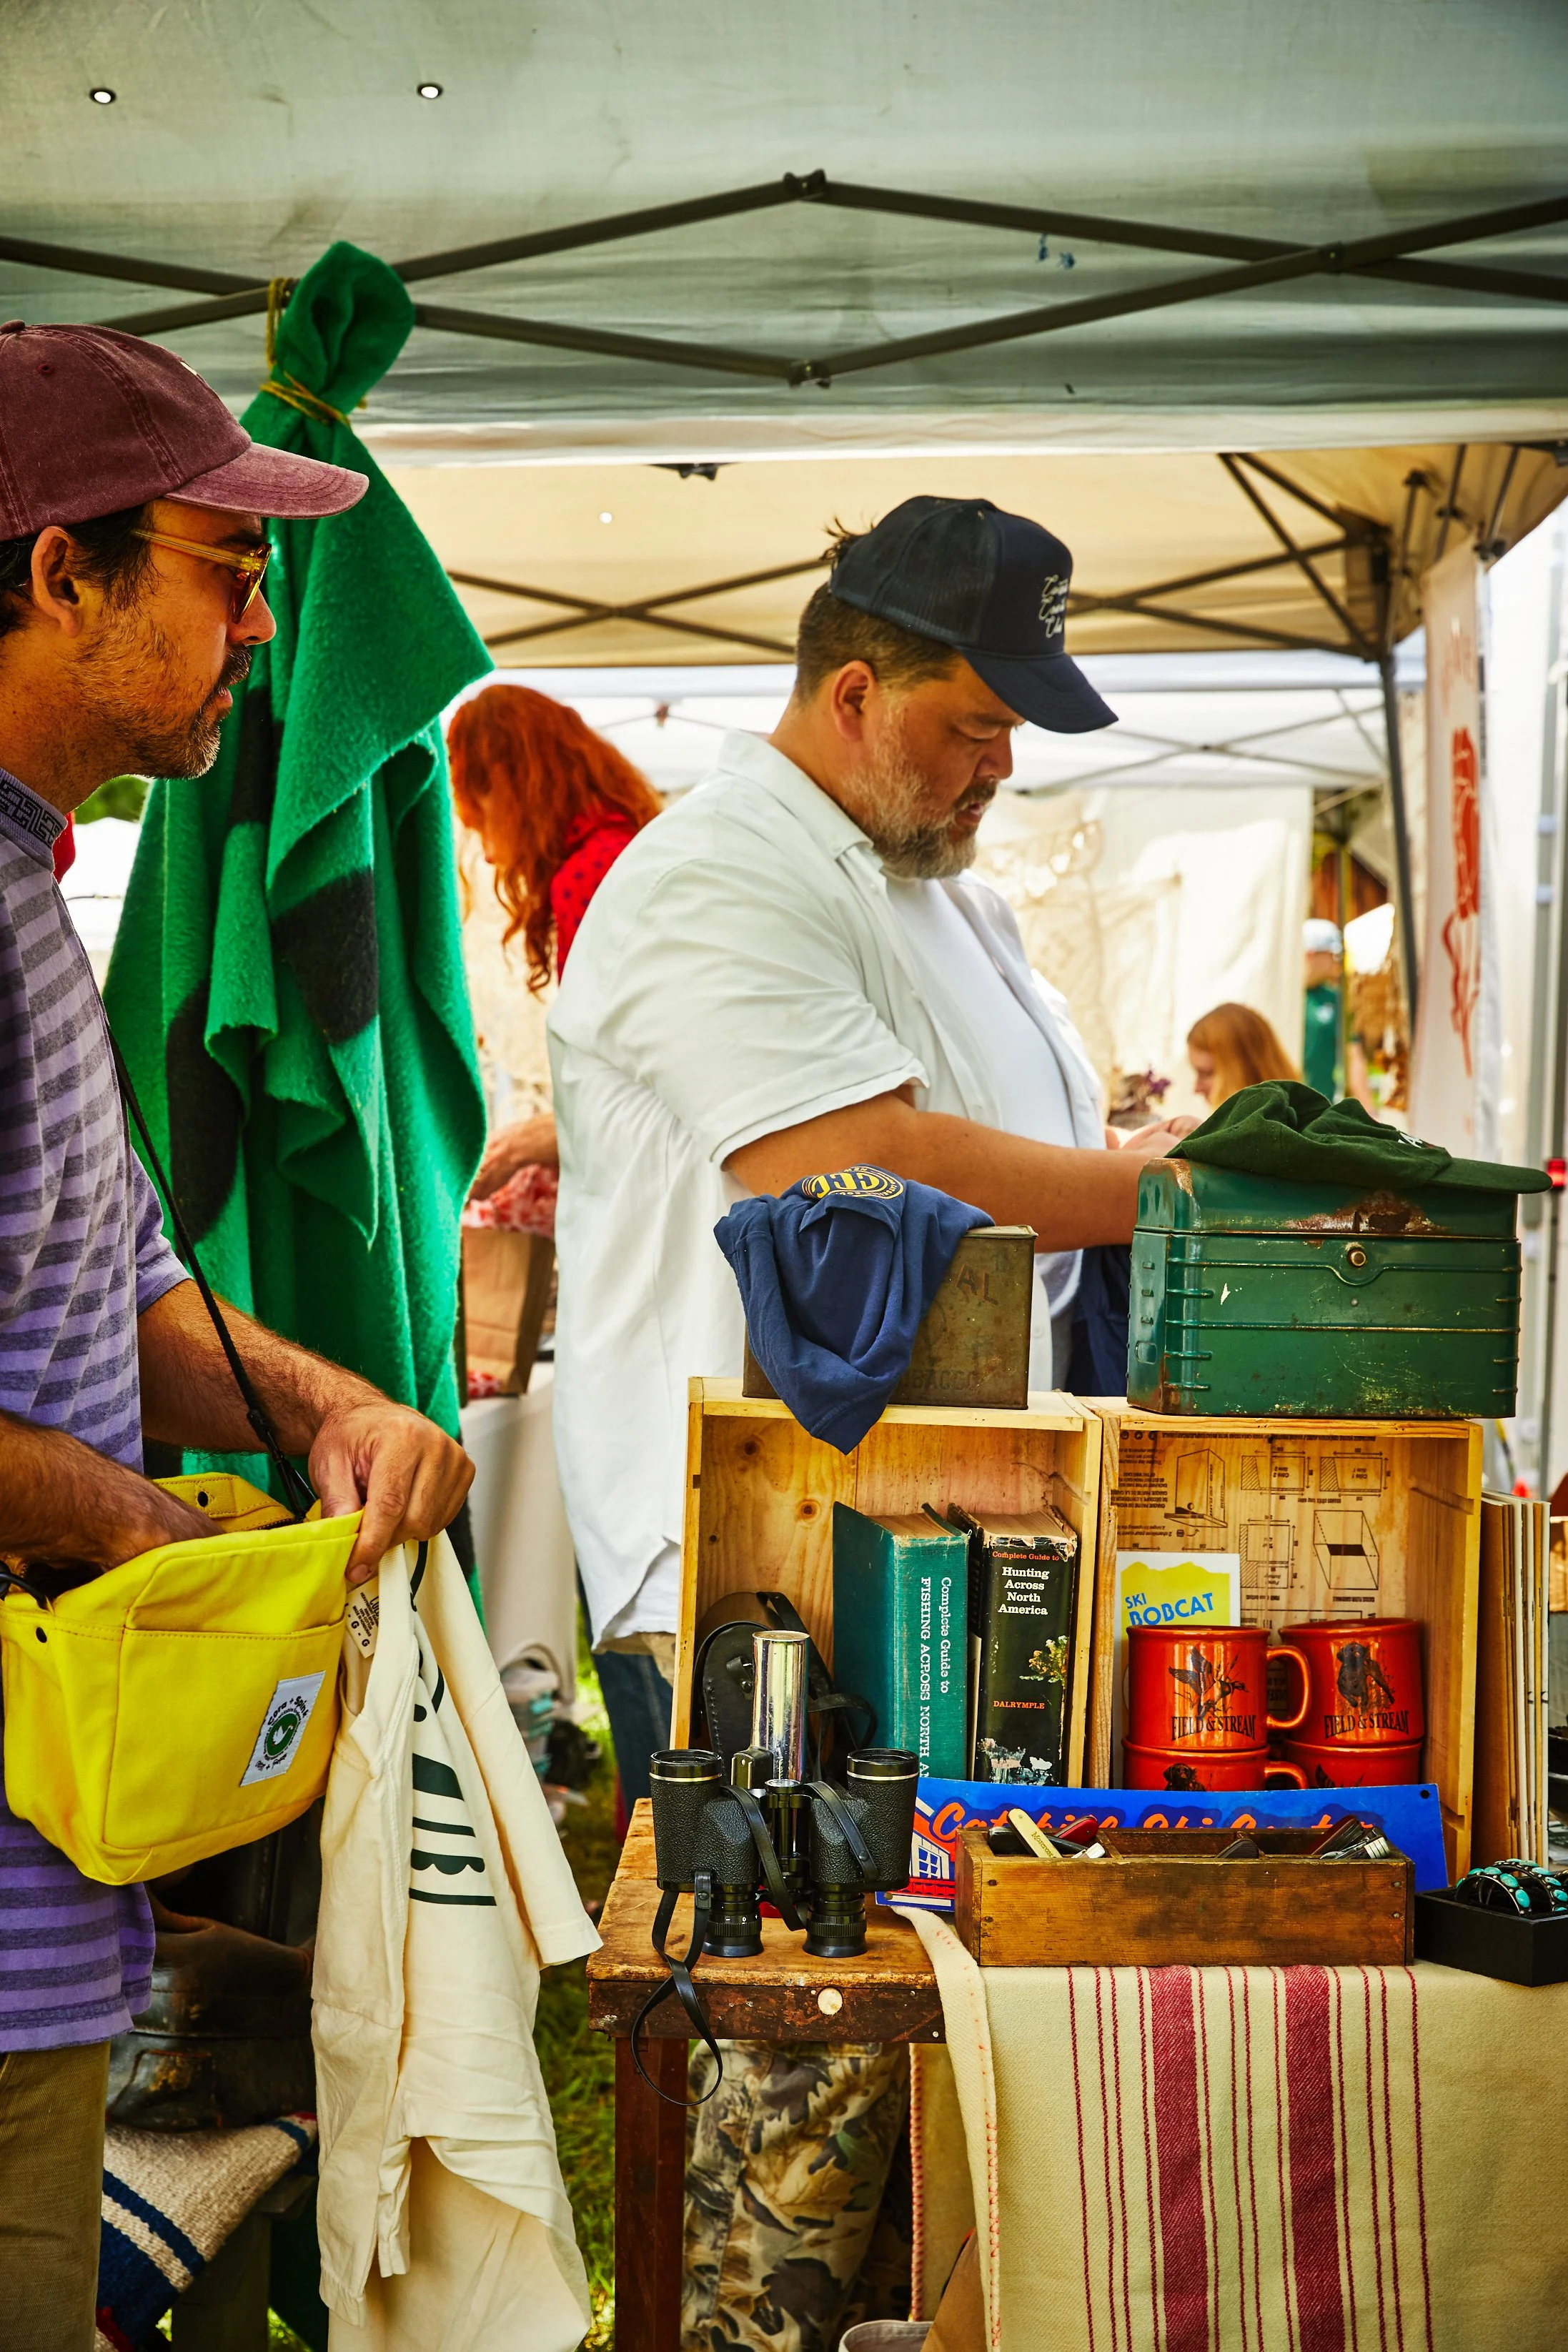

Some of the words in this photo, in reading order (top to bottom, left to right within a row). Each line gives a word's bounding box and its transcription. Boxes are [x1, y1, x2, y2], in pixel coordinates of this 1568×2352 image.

[992, 1551, 1027, 1560] Complete
[1001, 1566, 1051, 1580] Hunting
[1003, 1579, 1045, 1591] Across
[1006, 1591, 1041, 1602] North
[1124, 1592, 1148, 1609] SKI
[921, 1577, 931, 1641] FISHING
[939, 1577, 952, 1637] Complete
[997, 1603, 1048, 1615] America
[1128, 1592, 1215, 1626] BOBCAT
[359, 1619, 372, 1637] HONDURAS
[363, 1617, 372, 1630] COTTON
[940, 1639, 951, 1678] Guide
[920, 1643, 931, 1702] ACROSS
[940, 1679, 950, 1694] to
[267, 1701, 287, 1727] Cora
[993, 1700, 1046, 1710] DALRYMPLE
[919, 1706, 931, 1758] NORTH
[1171, 1715, 1204, 1741] FIELD
[1206, 1715, 1216, 1732] &
[1217, 1714, 1256, 1740] STREAM
[1324, 1715, 1356, 1740] FIELD
[1357, 1715, 1368, 1730] &
[1369, 1711, 1409, 1735] STREAM
